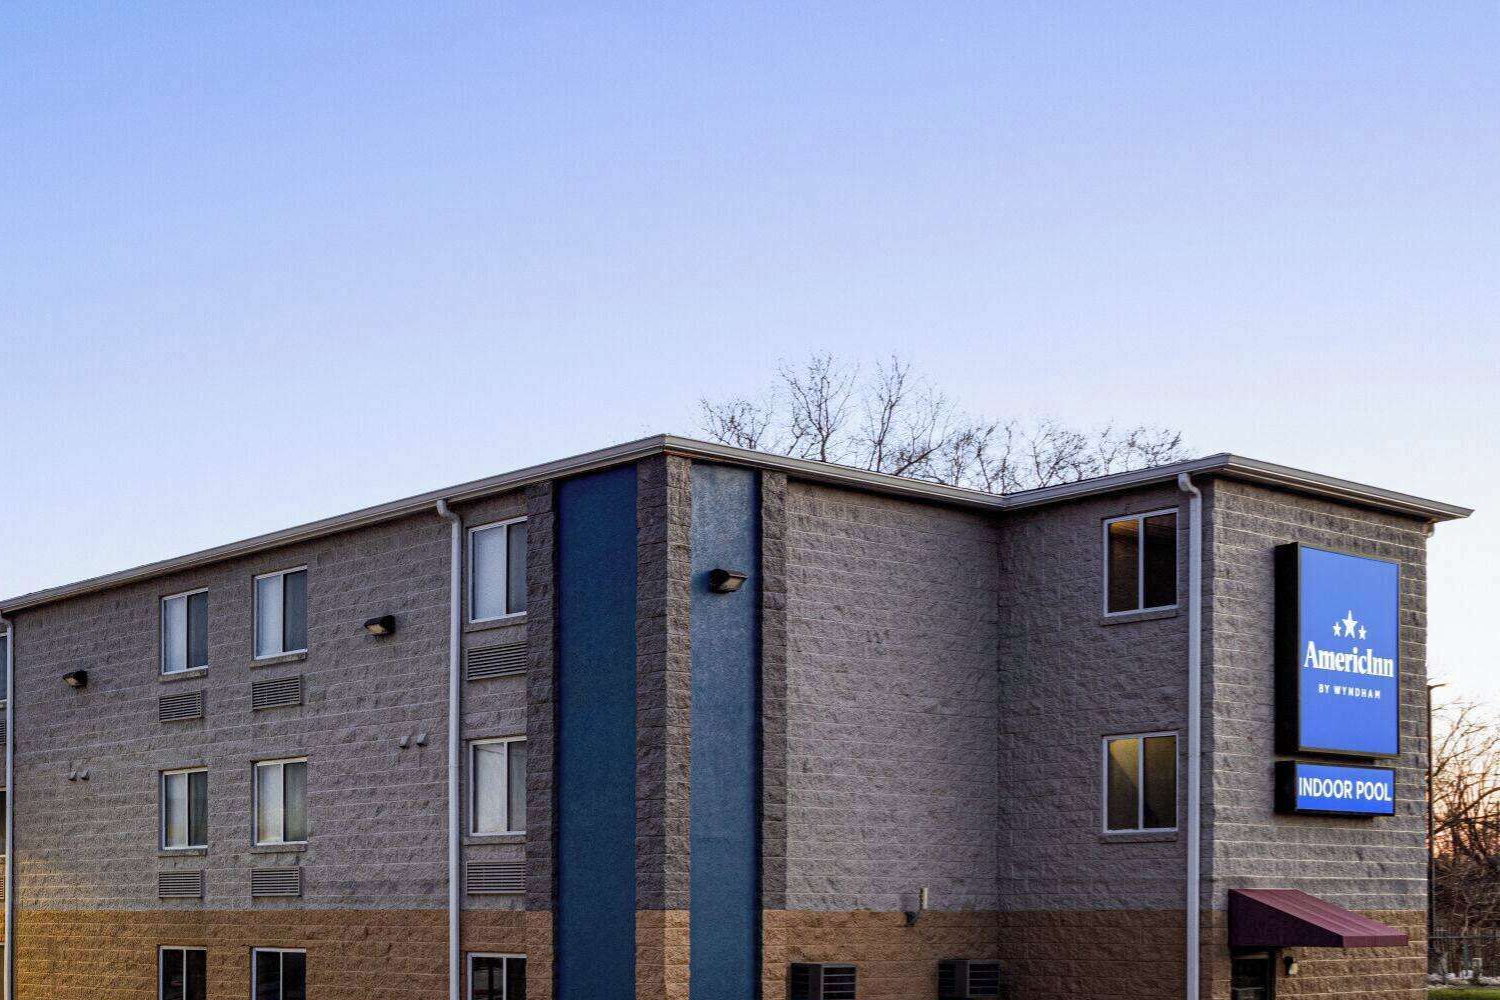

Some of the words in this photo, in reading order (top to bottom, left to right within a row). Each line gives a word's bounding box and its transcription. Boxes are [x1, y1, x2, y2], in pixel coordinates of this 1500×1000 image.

[1304, 640, 1394, 678] AmericInn
[1318, 683, 1330, 694] BY
[1333, 685, 1381, 699] WYNDHAM
[1299, 777, 1353, 799] INDOOR
[1356, 780, 1392, 802] POOL
